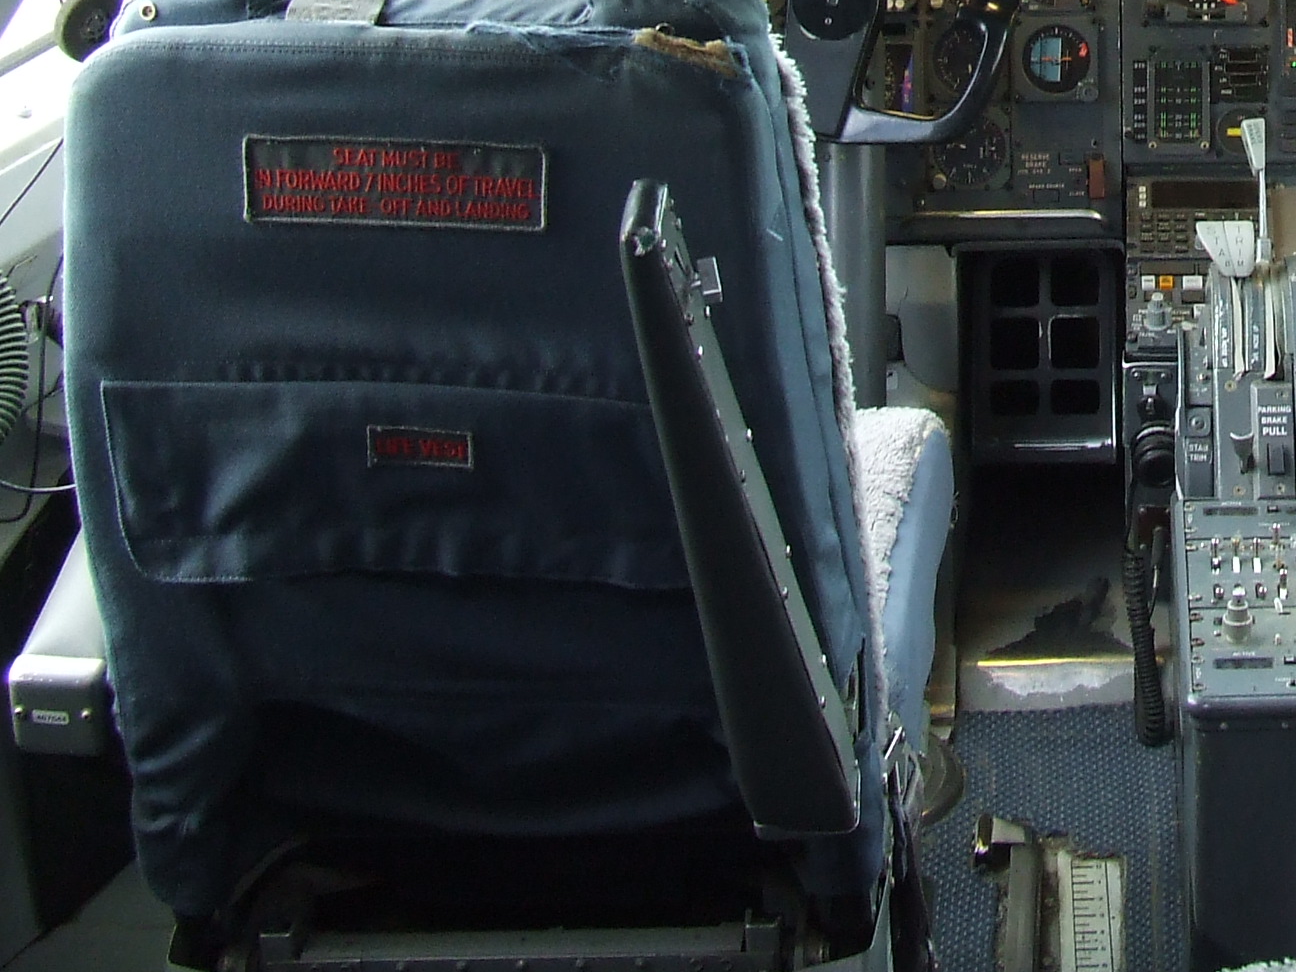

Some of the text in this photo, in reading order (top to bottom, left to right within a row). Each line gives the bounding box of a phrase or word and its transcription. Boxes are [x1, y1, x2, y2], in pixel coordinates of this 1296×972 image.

[333, 147, 458, 170] SEAT MUST BE
[275, 169, 362, 192] FORWARD
[377, 173, 441, 194] INCHES
[446, 174, 470, 196] OF
[474, 175, 538, 200] TRAVEL
[262, 194, 326, 213] DURING
[415, 198, 452, 217] AND
[456, 200, 531, 220] LANDING
[1261, 416, 1288, 424] BRAKE
[1262, 426, 1288, 436] PULL
[1189, 453, 1208, 462] TRIM
